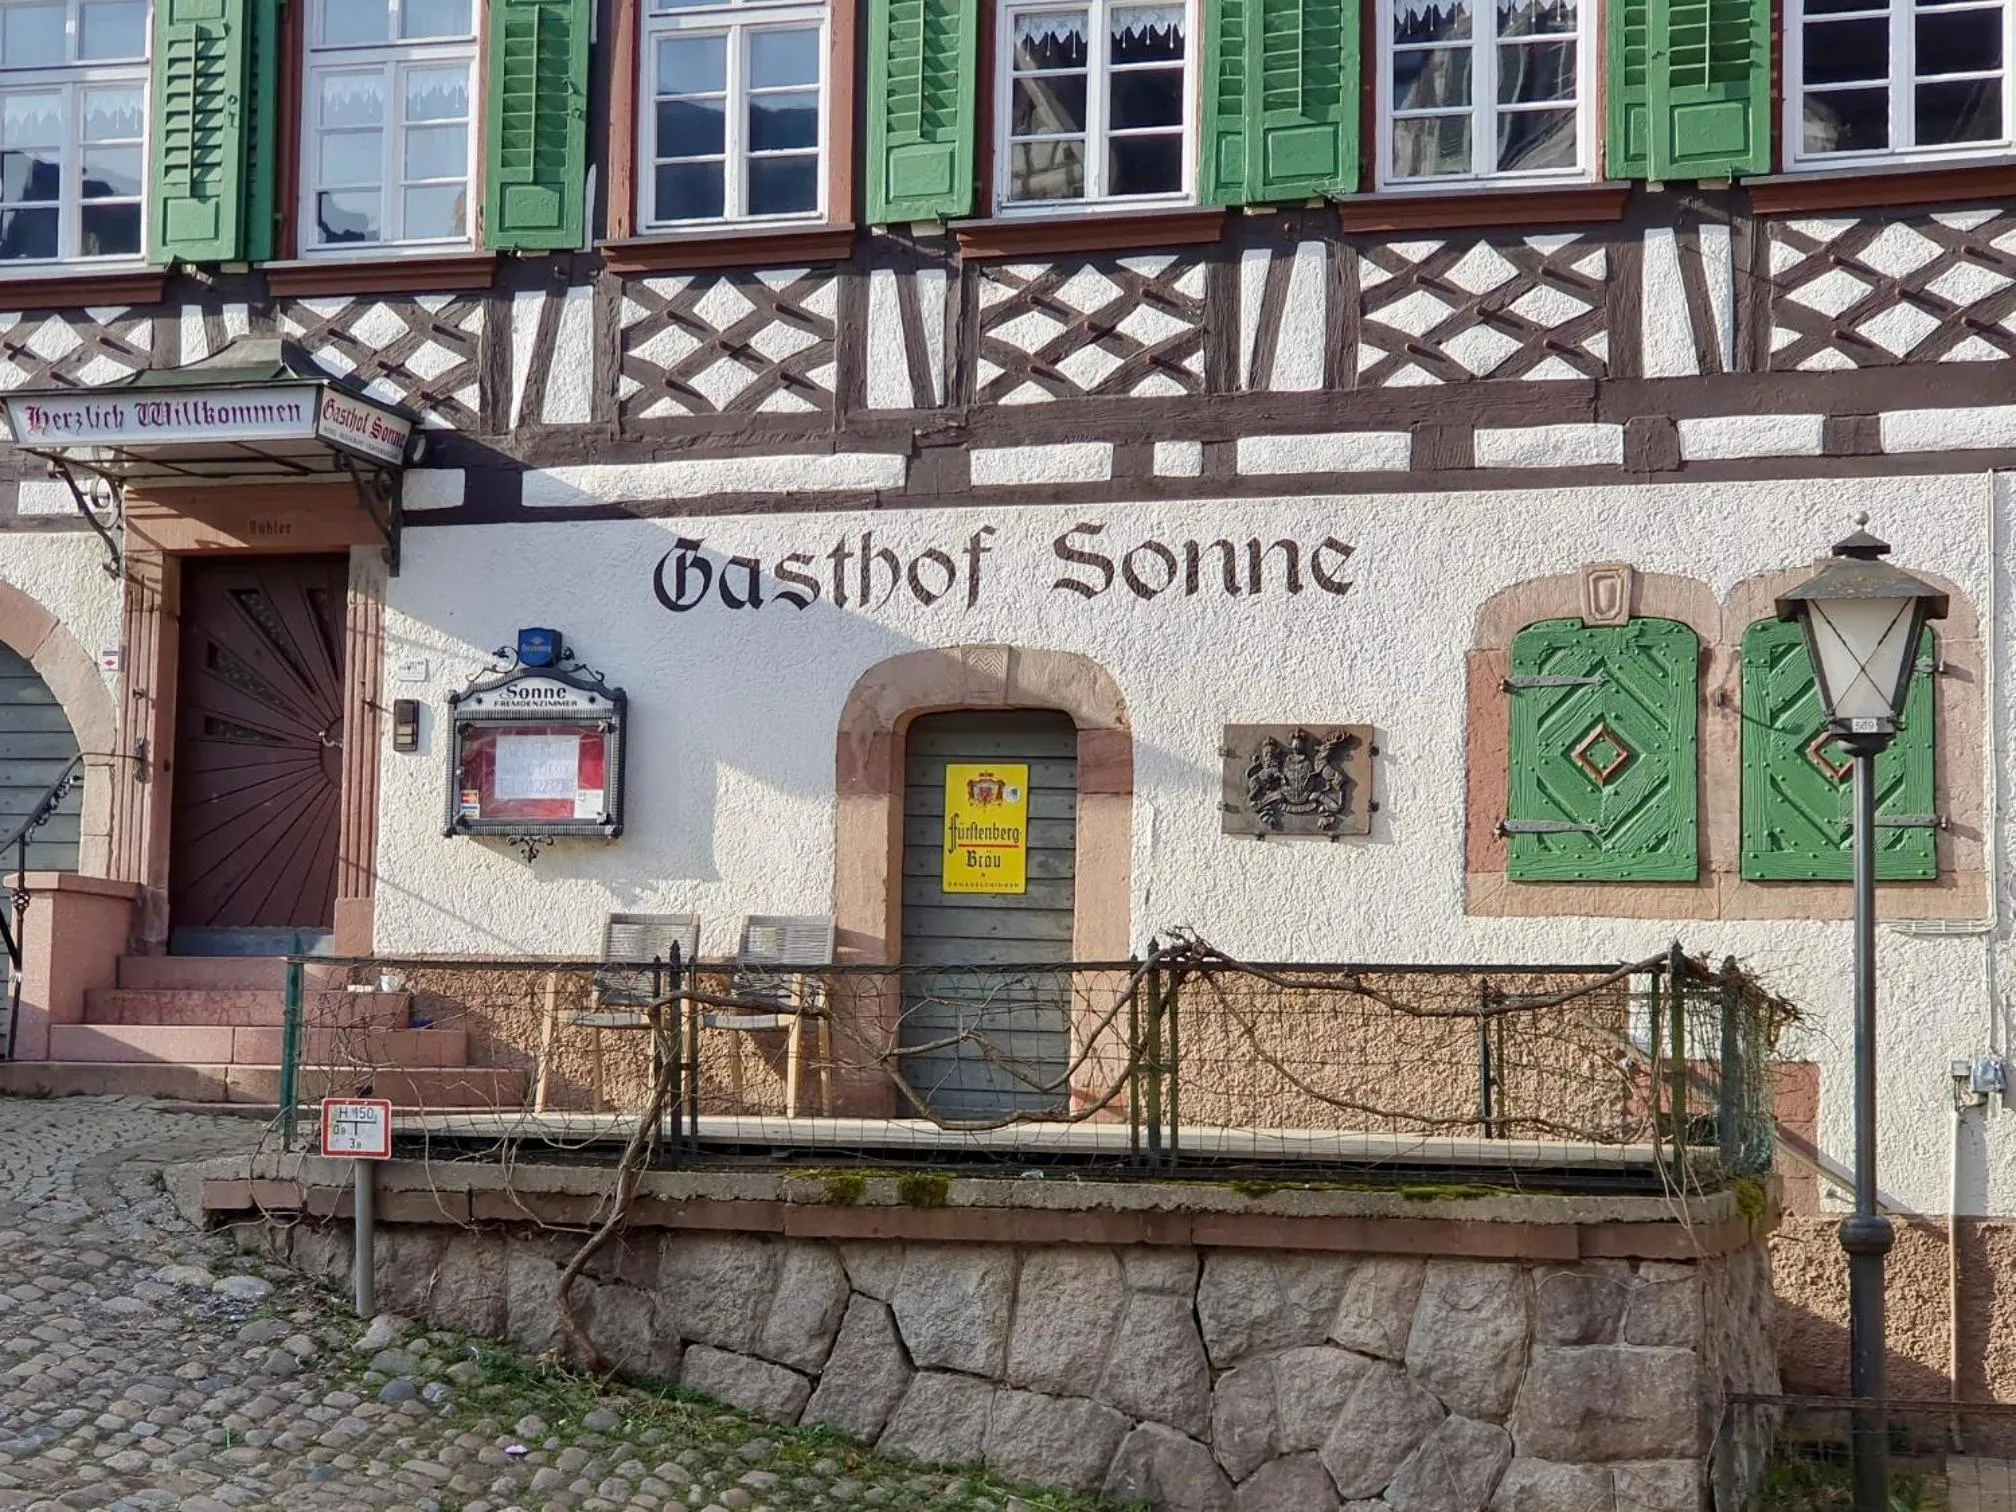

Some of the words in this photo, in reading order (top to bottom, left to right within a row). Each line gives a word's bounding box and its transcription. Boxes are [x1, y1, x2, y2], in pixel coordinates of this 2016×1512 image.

[24, 403, 124, 436] Herzlich
[134, 401, 301, 428] Willkommen
[322, 398, 370, 434] Gasthof
[369, 416, 411, 450] Sonne
[653, 524, 996, 612] Gasthof
[1052, 521, 1357, 600] Sonne
[499, 683, 567, 699] Sonne
[966, 850, 1001, 868] Bräu
[352, 1107, 374, 1119] 150
